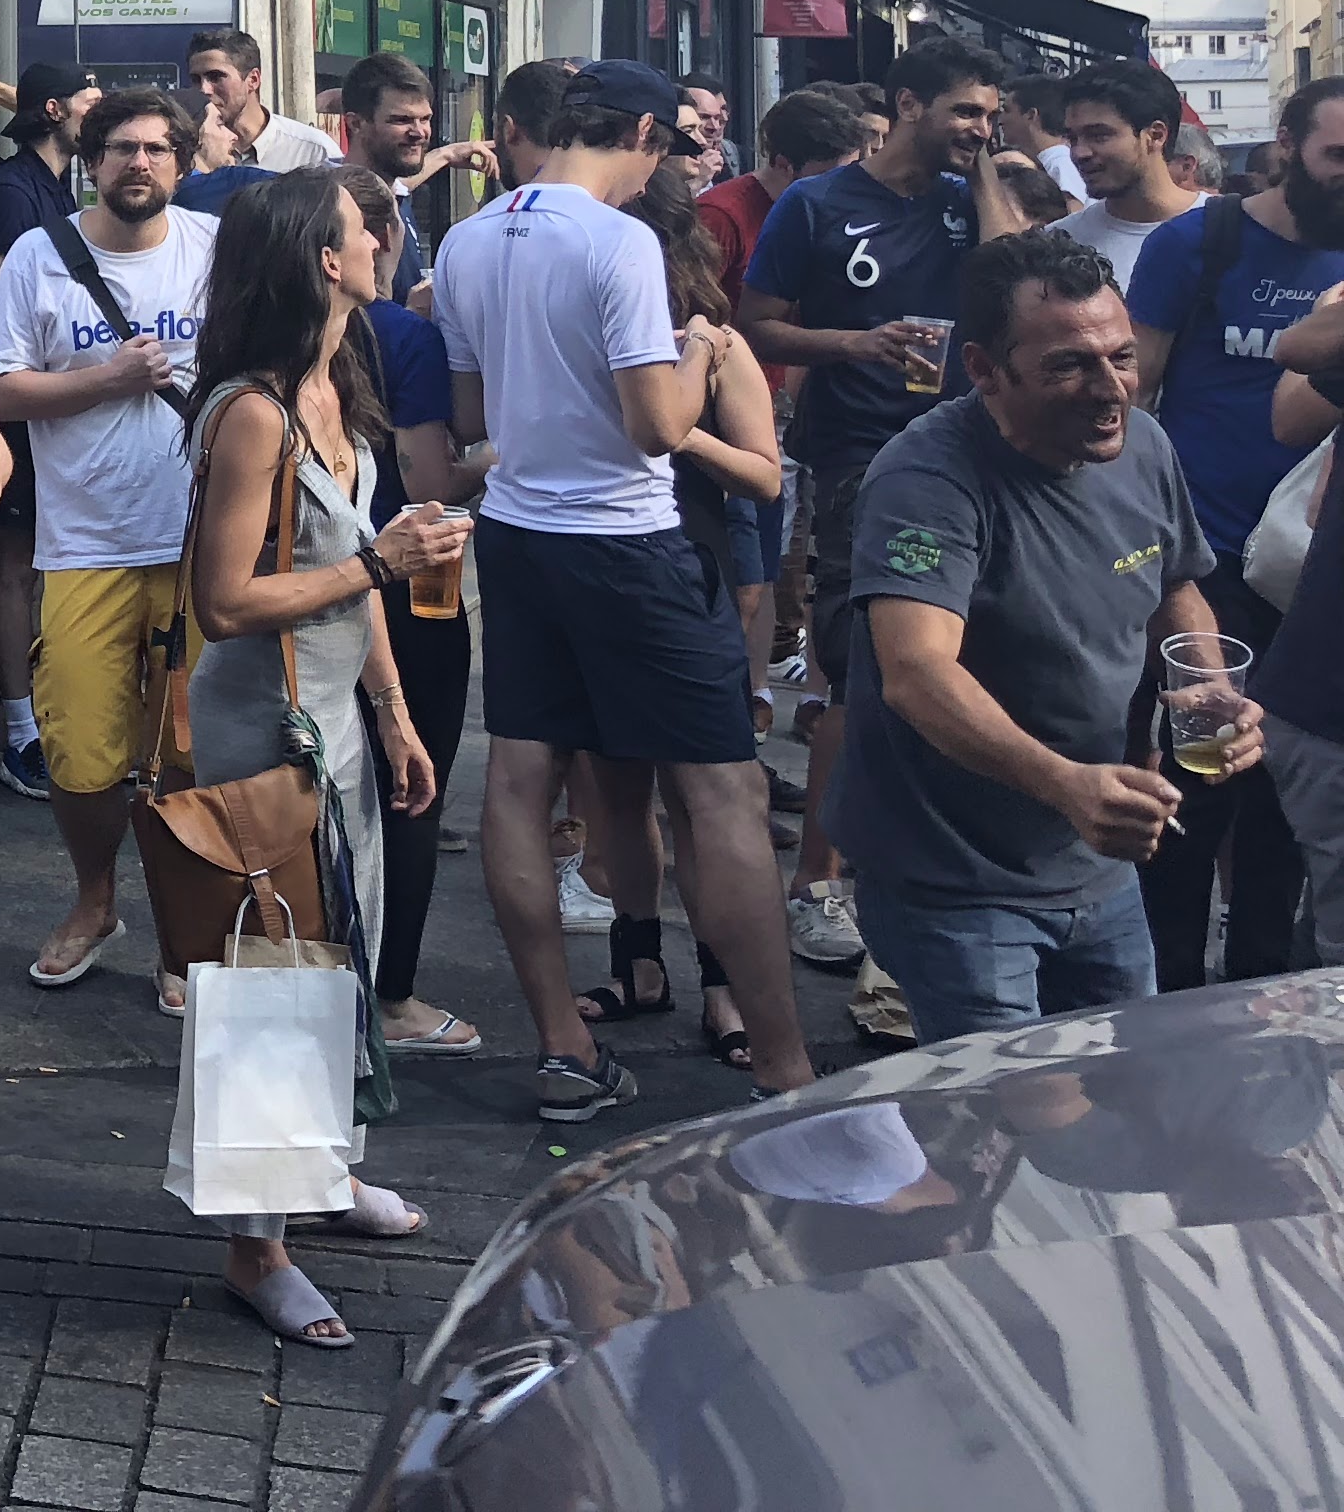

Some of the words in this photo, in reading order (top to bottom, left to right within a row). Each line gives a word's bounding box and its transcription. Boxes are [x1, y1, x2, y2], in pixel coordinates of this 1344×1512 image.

[78, 8, 114, 17] VOS
[118, 7, 178, 17] GAINS
[846, 238, 880, 288] 6
